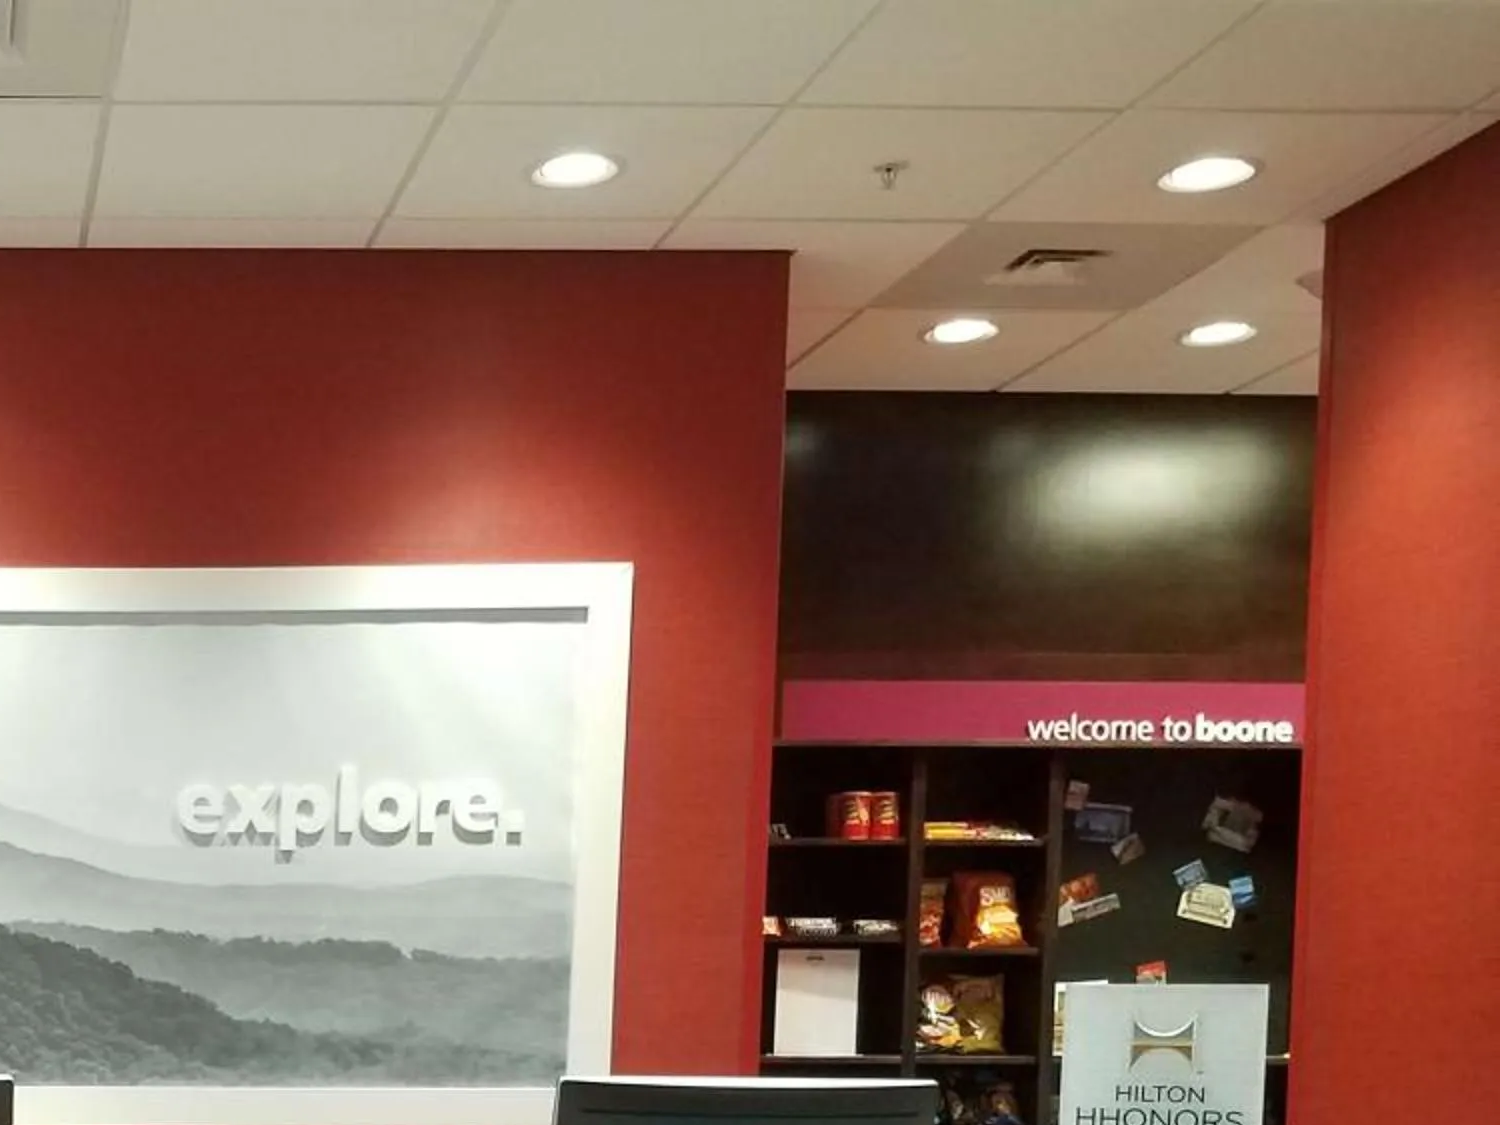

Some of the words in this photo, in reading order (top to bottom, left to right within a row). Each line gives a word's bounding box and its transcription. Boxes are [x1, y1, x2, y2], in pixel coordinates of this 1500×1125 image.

[1027, 712, 1154, 742] welcome
[1161, 715, 1192, 742] to
[1195, 712, 1294, 743] boone
[176, 763, 525, 854] explore.
[1115, 1085, 1205, 1104] HILTON
